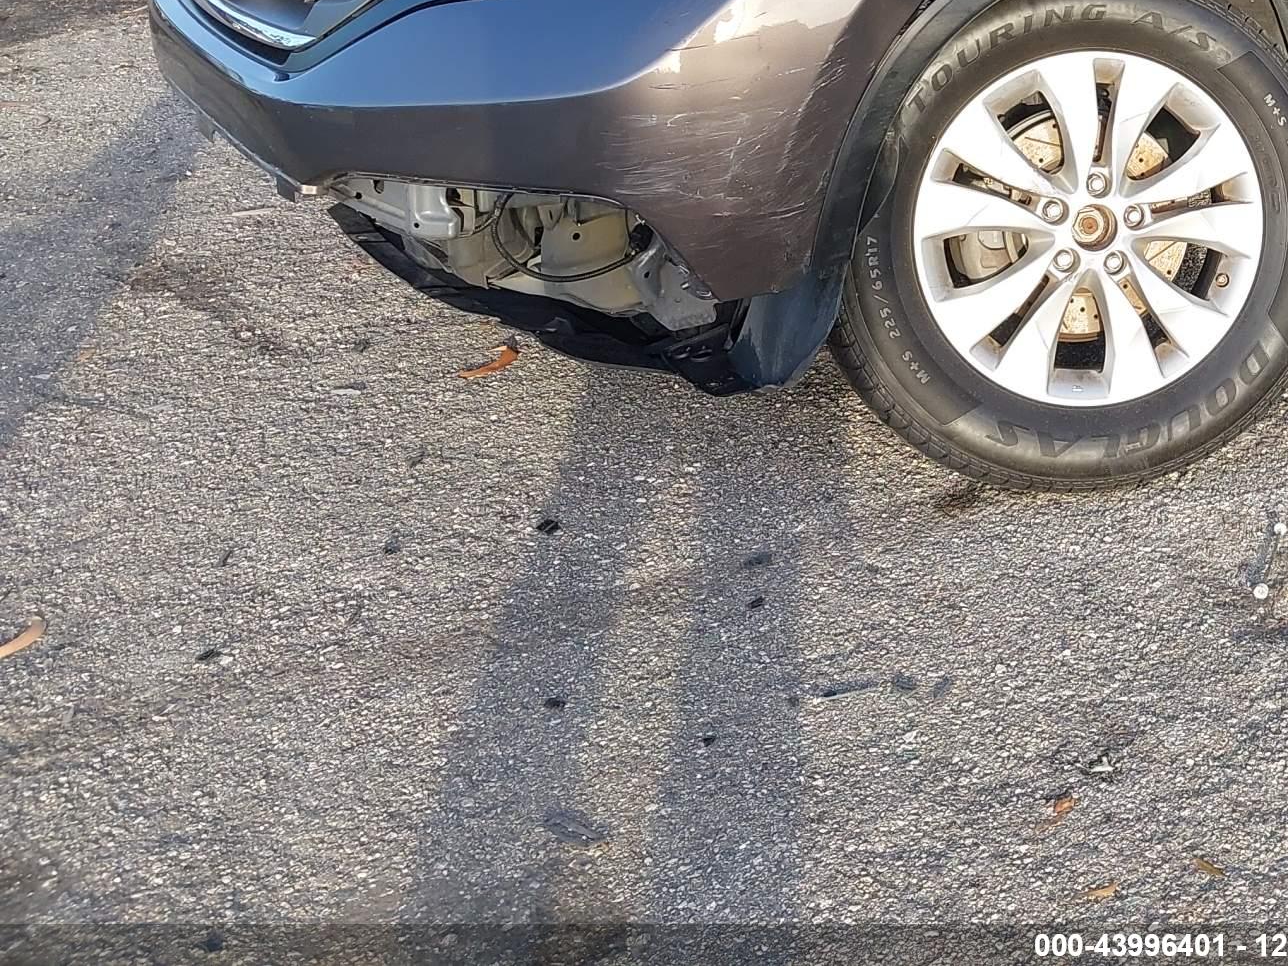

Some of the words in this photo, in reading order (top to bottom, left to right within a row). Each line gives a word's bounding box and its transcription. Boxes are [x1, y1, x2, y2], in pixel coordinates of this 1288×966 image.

[904, 4, 1107, 114] TOURING
[1128, 10, 1217, 52] A/S
[1263, 93, 1287, 127] M+S
[865, 236, 901, 340] 225/65R17
[902, 350, 932, 385] M+S
[984, 340, 1271, 459] DOUGLAS
